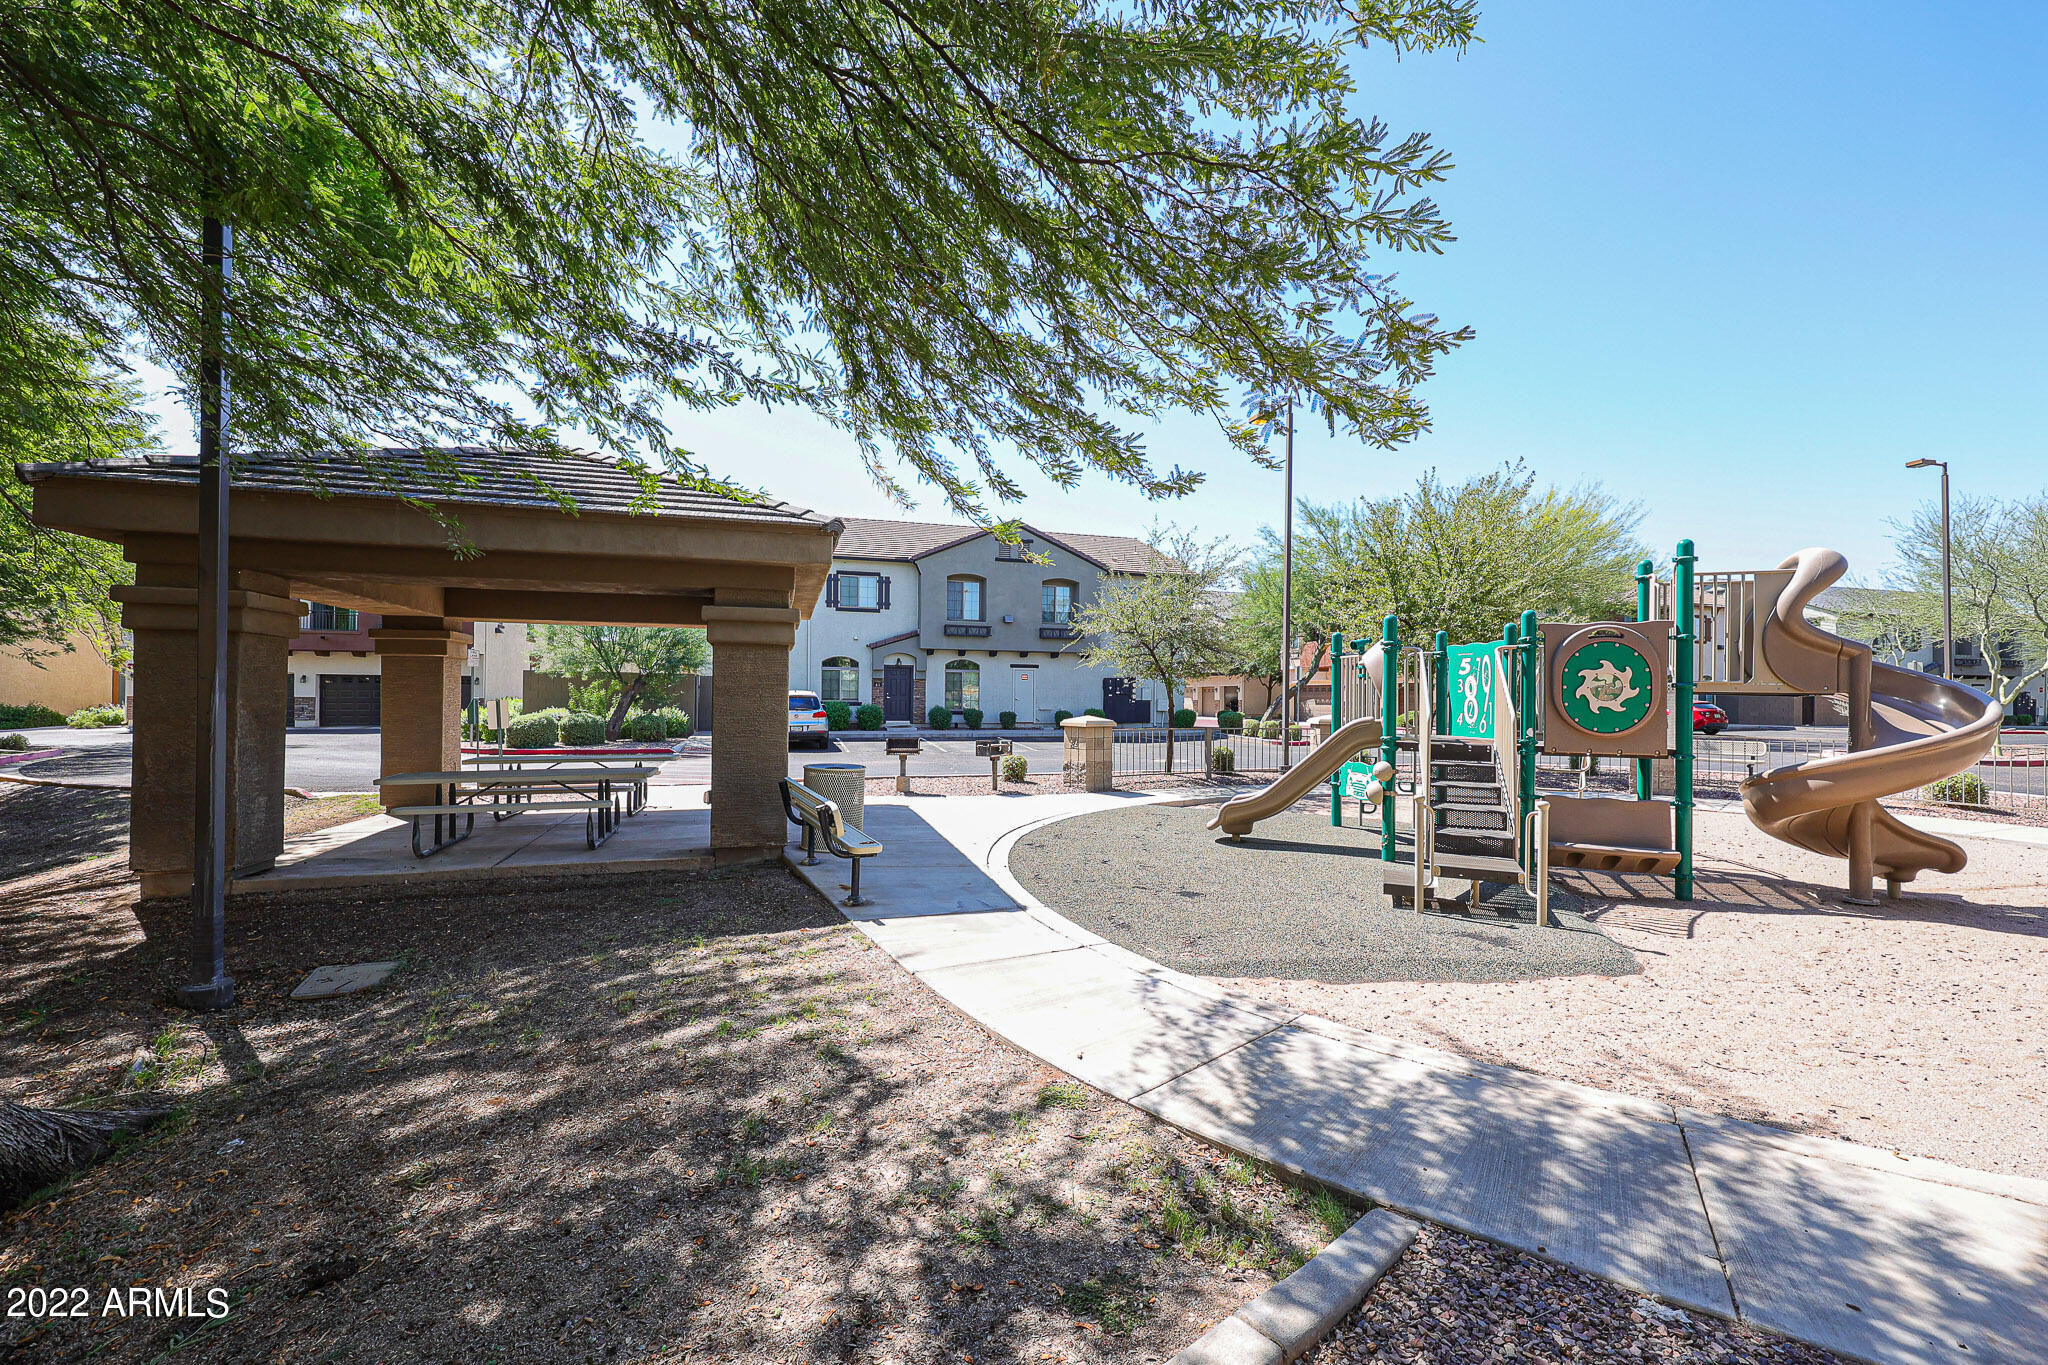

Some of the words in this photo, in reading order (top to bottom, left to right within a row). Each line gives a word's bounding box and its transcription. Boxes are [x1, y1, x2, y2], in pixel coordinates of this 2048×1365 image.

[1458, 657, 1471, 675] 5
[1457, 679, 1464, 693] 3
[1482, 654, 1491, 713] 9
[1464, 675, 1478, 725] 8
[1468, 701, 1473, 716] 2
[1457, 713, 1463, 726] 4
[1479, 713, 1487, 734] 6
